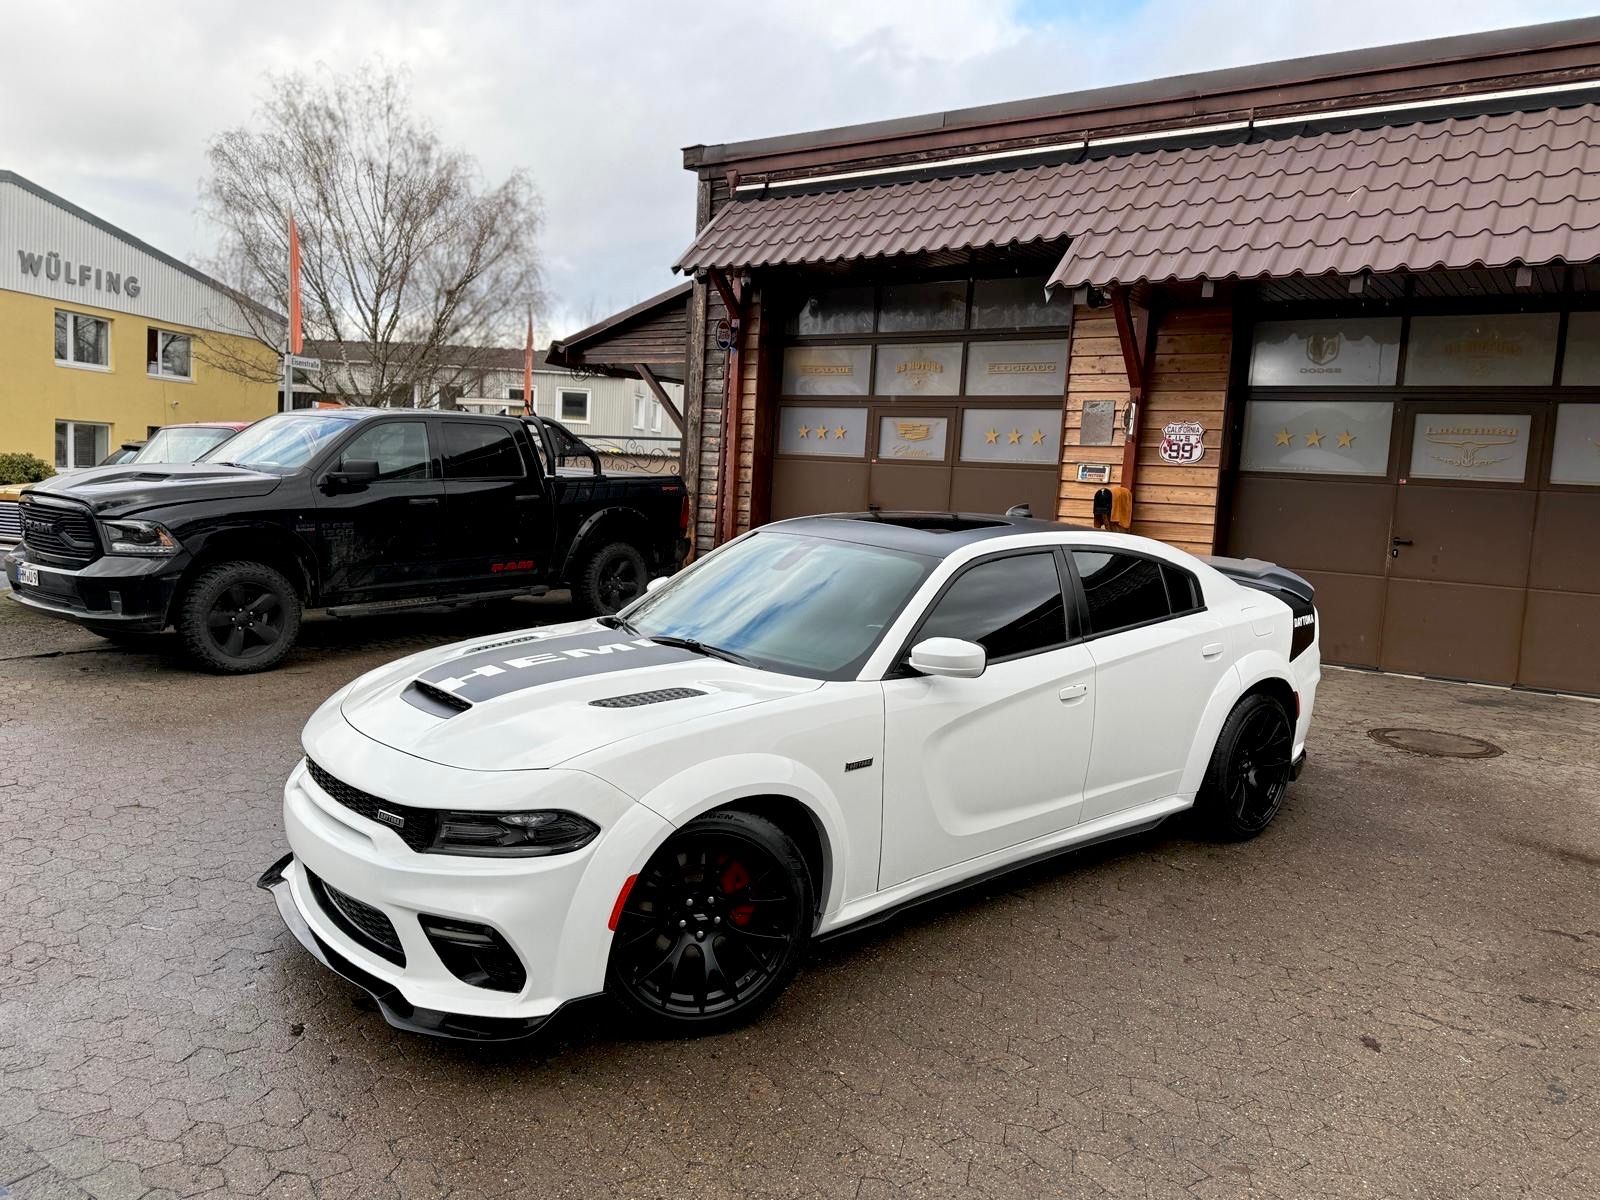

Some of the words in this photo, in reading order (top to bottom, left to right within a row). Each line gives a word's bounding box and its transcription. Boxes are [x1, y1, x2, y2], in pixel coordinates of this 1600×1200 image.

[17, 249, 141, 298] WÜLFING
[1299, 367, 1342, 375] DODGE
[1166, 425, 1201, 434] CALIFORNIA
[1168, 443, 1194, 460] 99
[491, 558, 537, 574] RAM
[1294, 613, 1315, 628] DAYTONA
[434, 637, 662, 693] HEMI
